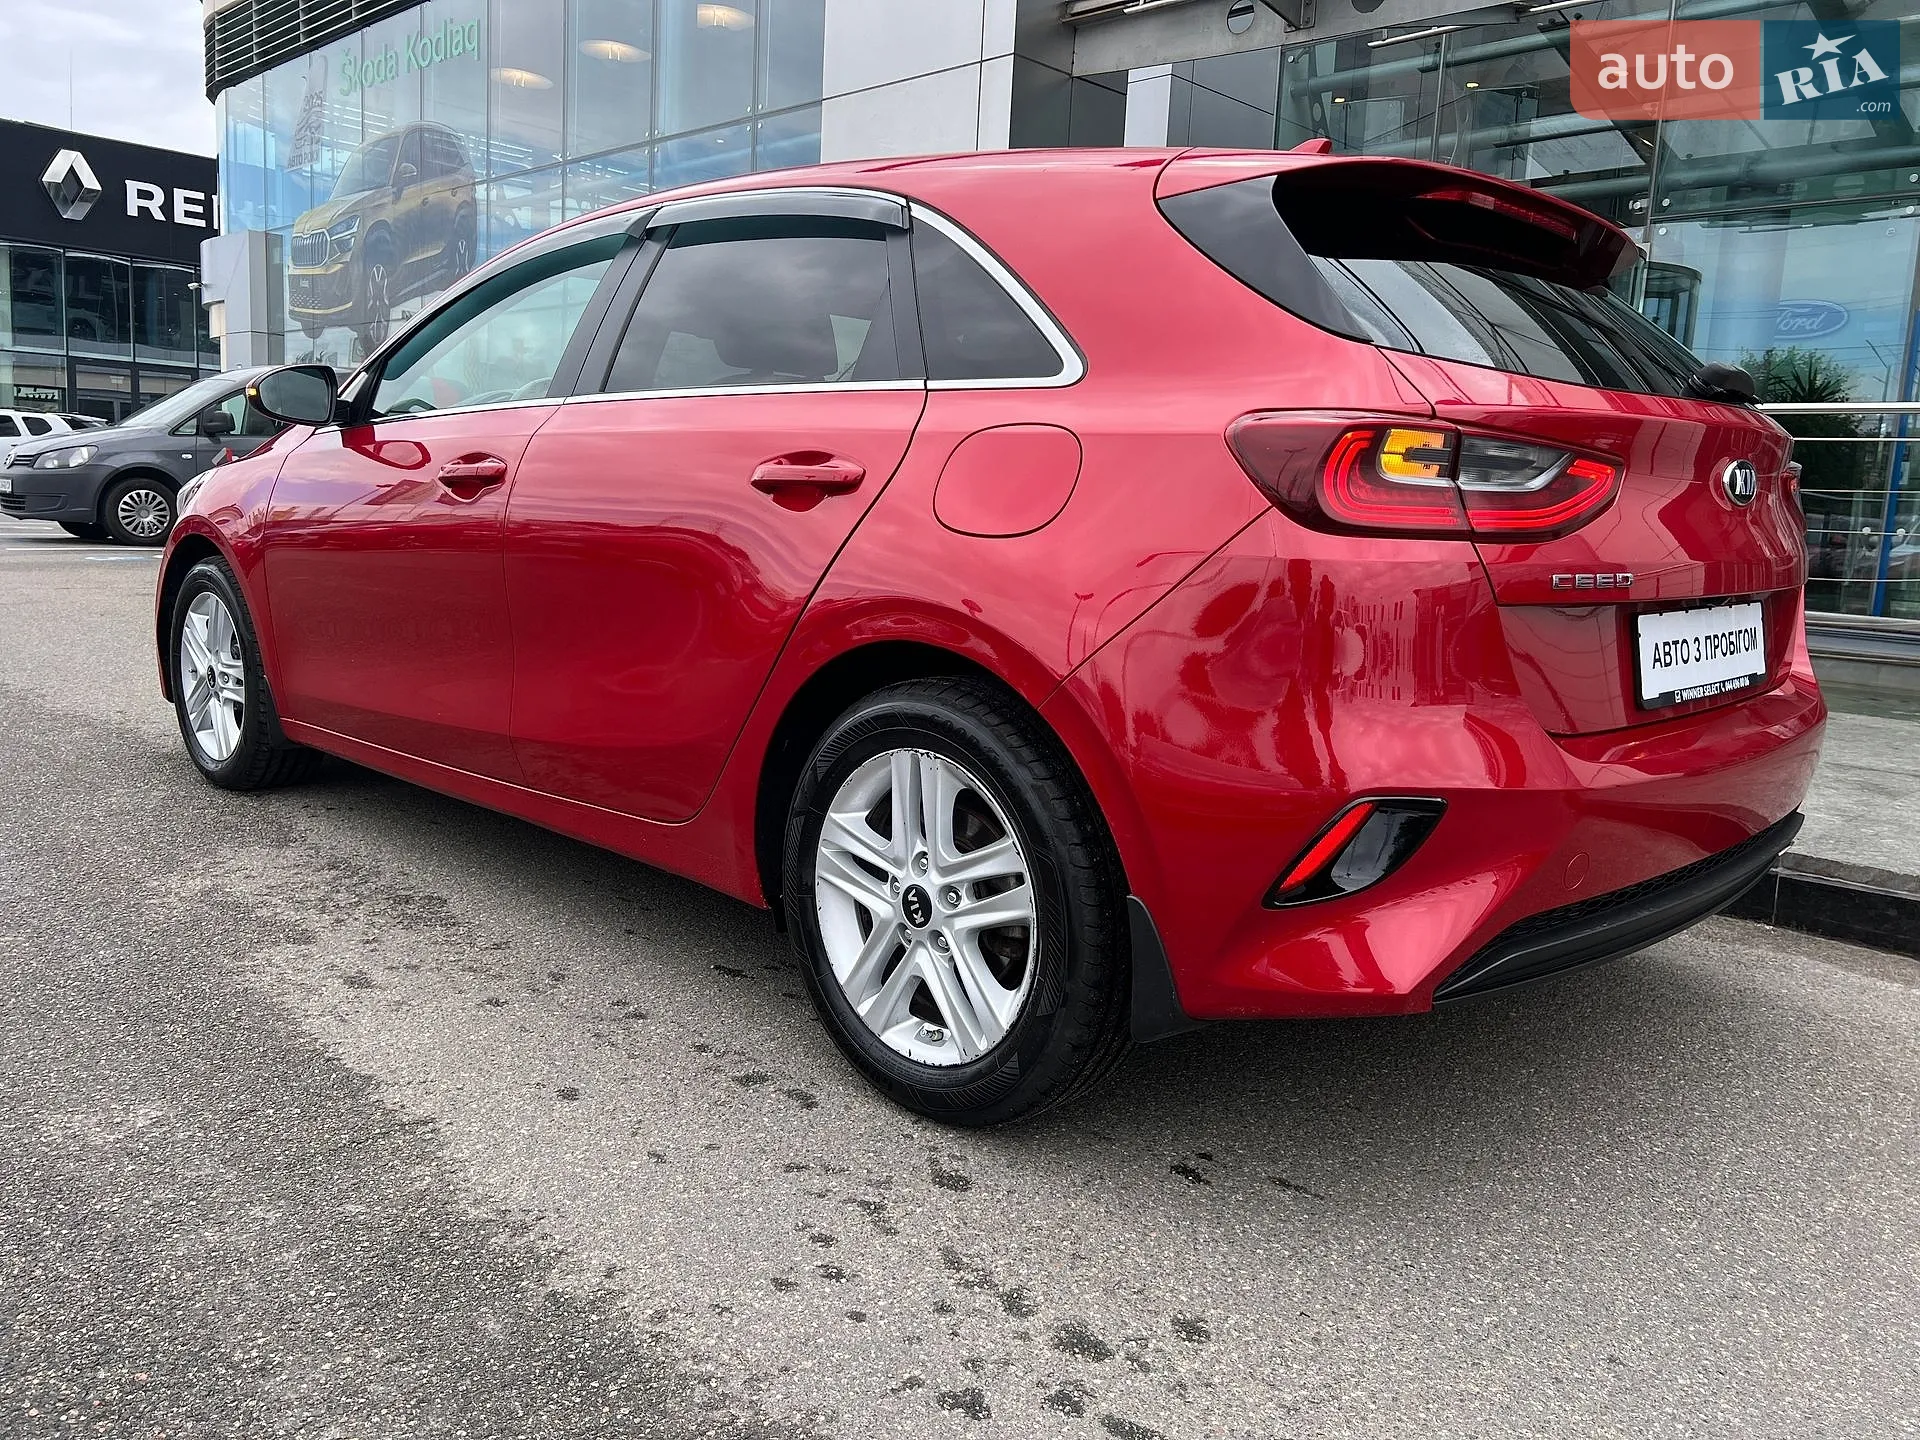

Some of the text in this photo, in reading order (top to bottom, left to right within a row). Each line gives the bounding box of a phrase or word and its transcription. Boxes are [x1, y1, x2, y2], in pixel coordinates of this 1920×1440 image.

[339, 17, 481, 97] Škoda Kodiaq
[125, 180, 218, 230] RE
[1552, 573, 1634, 589] CEED
[1652, 627, 1757, 669] АВТО З ПРОБІГОМ
[1681, 686, 1704, 701] WINNER
[1704, 682, 1721, 697] SELECT
[907, 888, 924, 924] KIA
